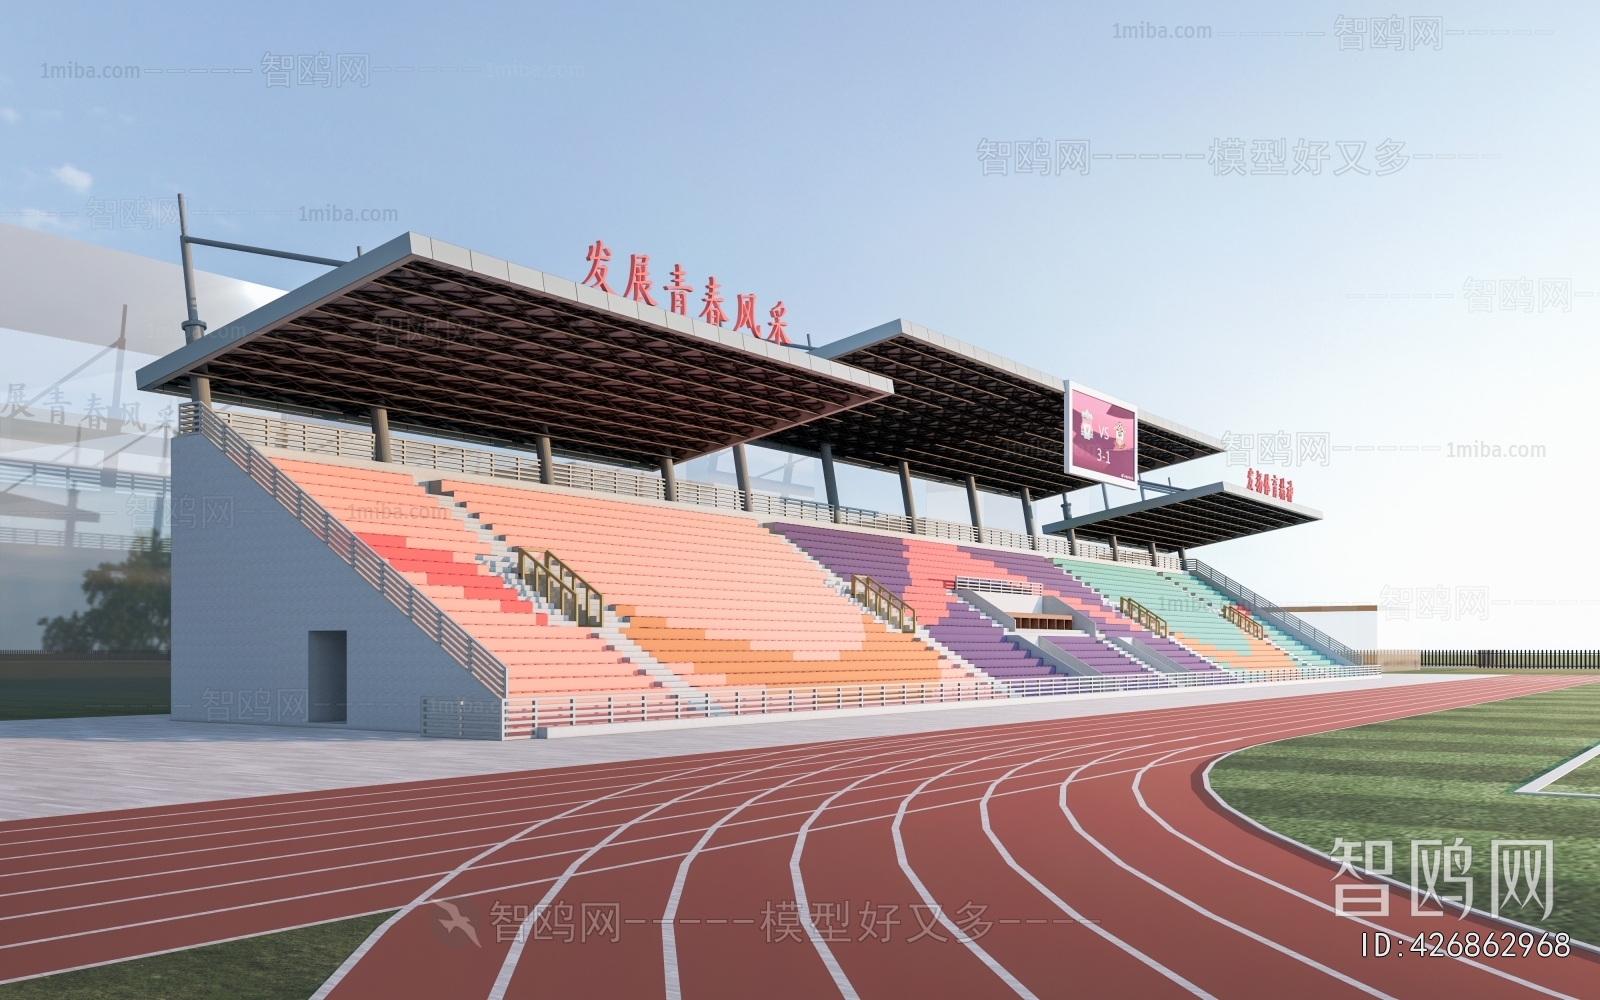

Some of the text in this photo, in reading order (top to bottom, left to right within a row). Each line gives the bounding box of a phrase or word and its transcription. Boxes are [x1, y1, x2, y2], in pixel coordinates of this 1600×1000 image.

[582, 240, 792, 345] 发展青春风采
[1098, 424, 1110, 440] VS
[1096, 447, 1111, 465] 3-1
